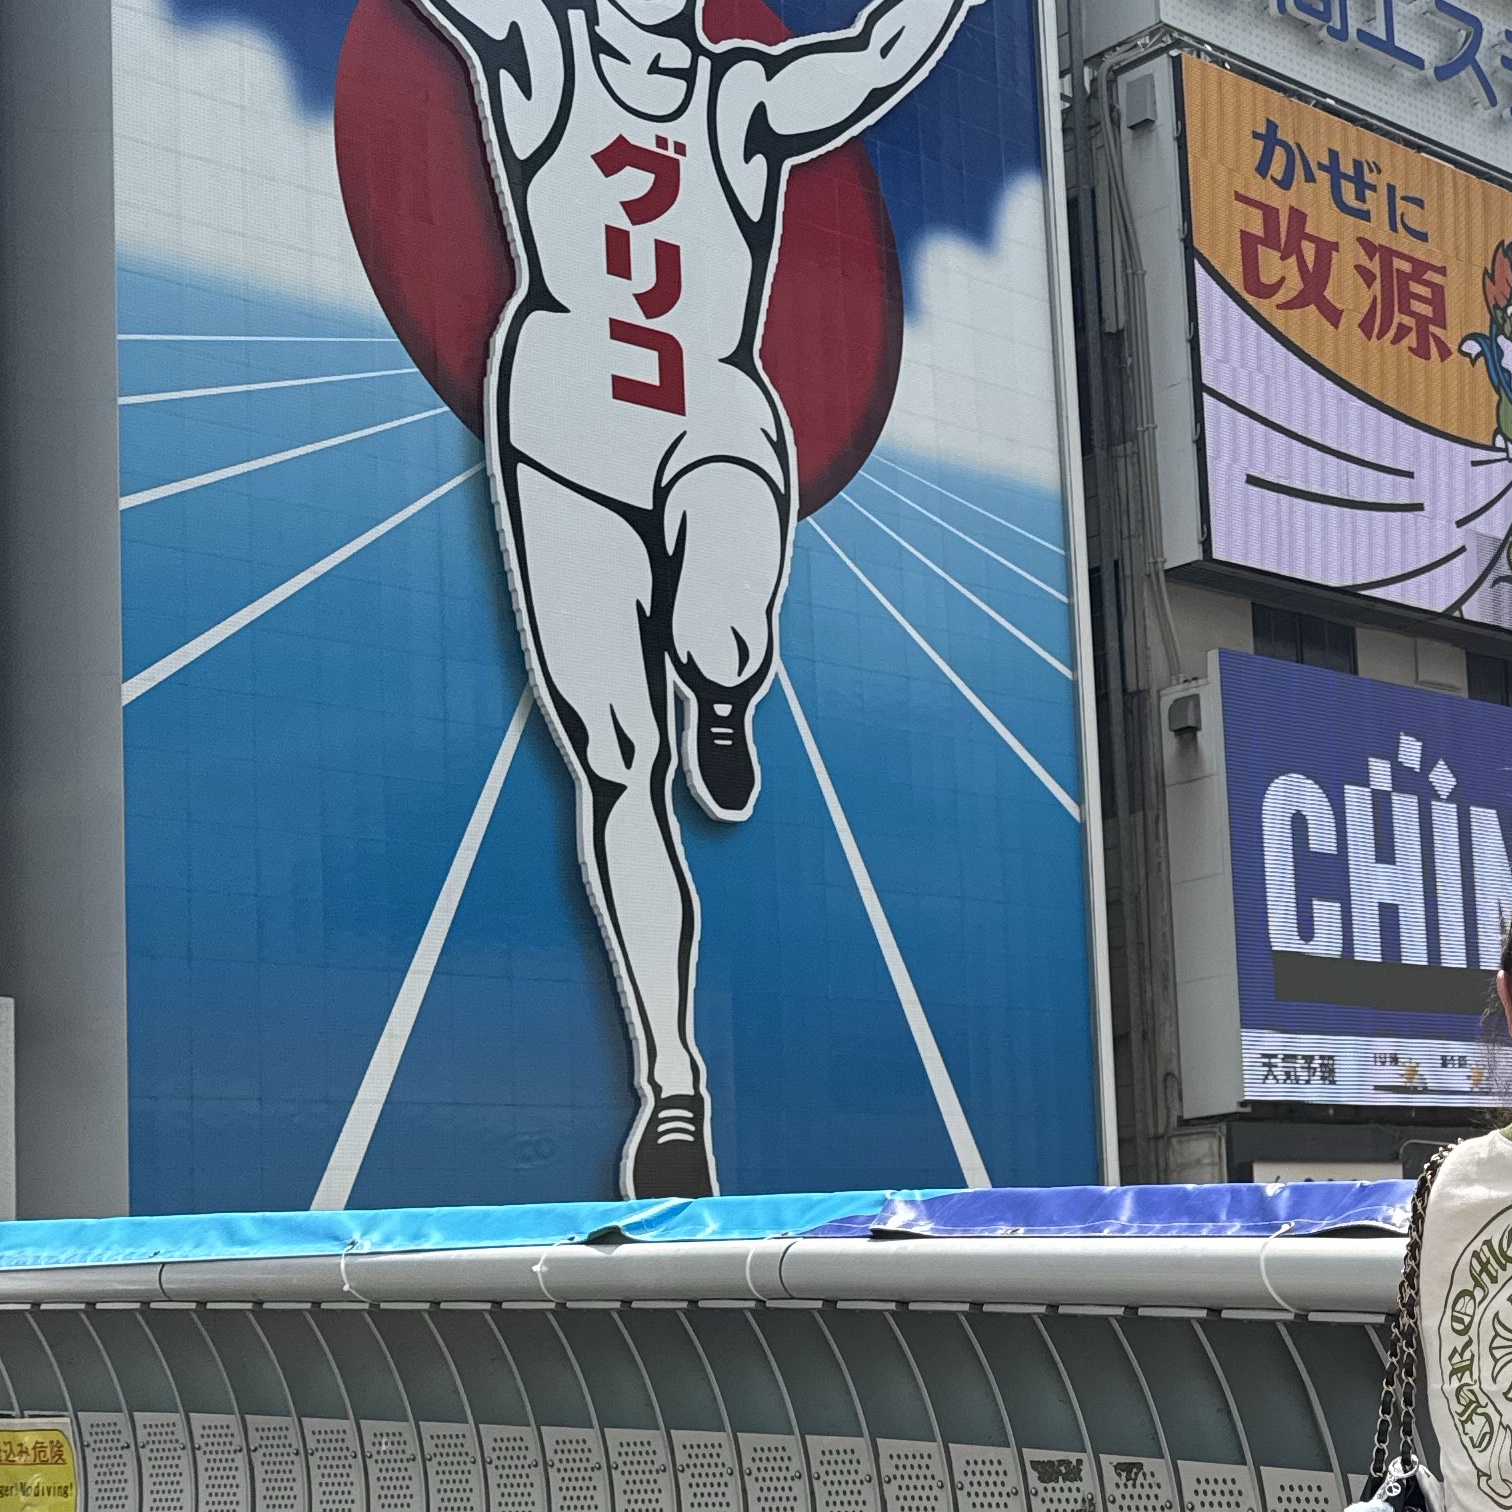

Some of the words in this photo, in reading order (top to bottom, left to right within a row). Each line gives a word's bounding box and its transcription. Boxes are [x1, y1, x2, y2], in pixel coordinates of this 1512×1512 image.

[1252, 117, 1429, 242] かぜに
[590, 134, 687, 418] グリコ
[1233, 190, 1461, 364] 改源
